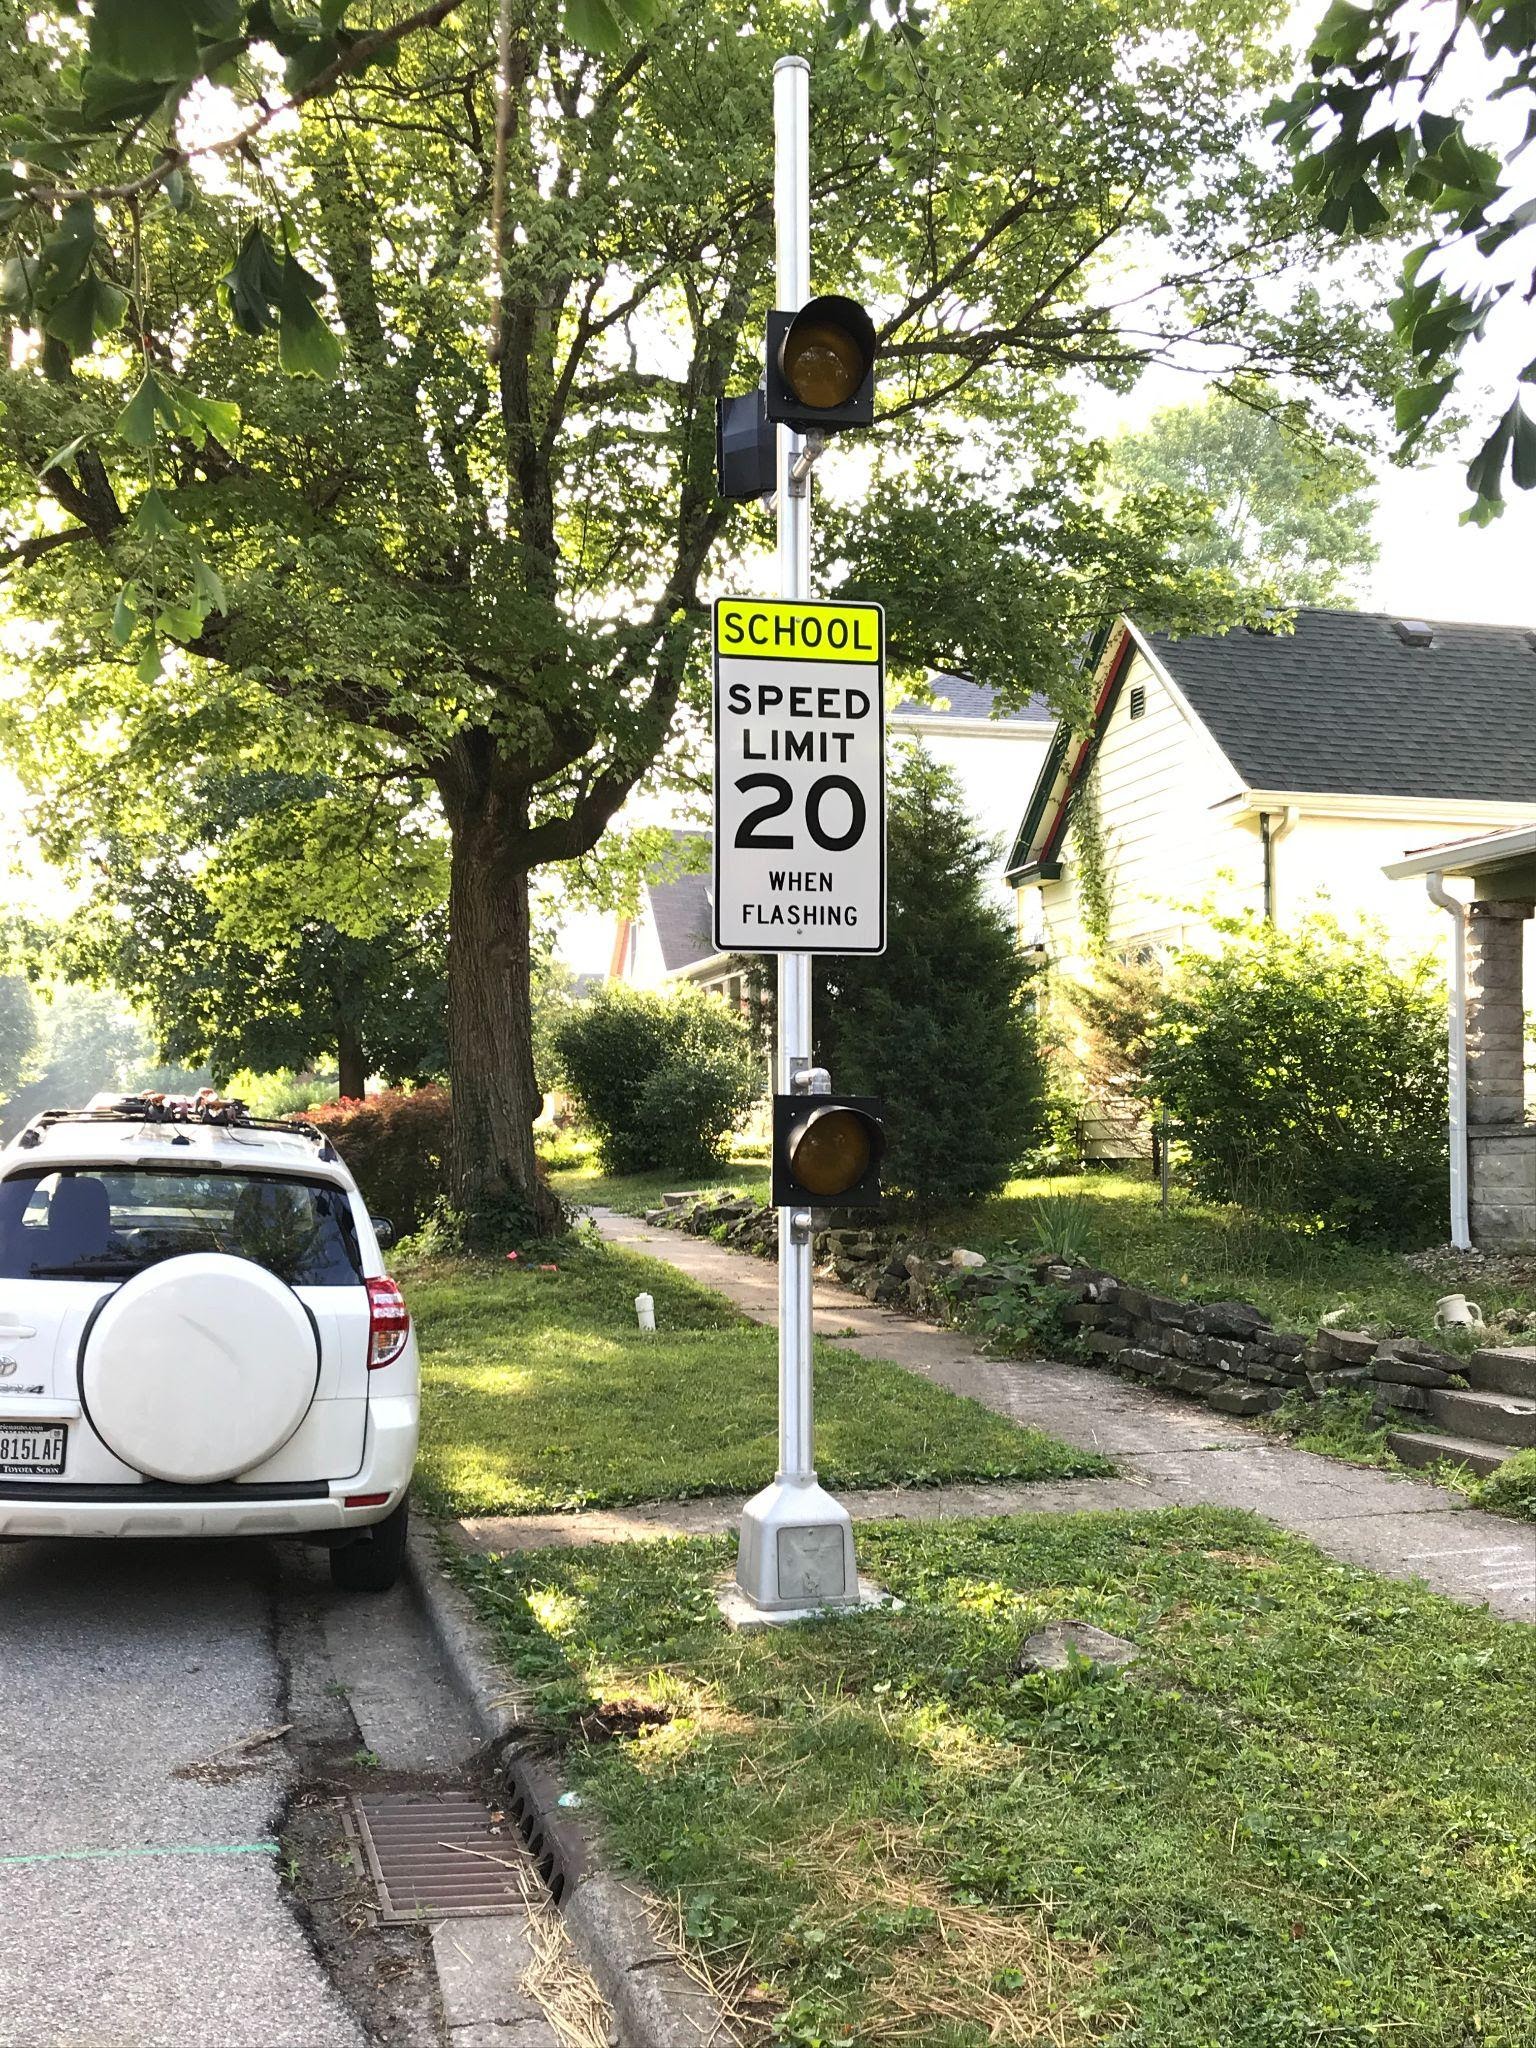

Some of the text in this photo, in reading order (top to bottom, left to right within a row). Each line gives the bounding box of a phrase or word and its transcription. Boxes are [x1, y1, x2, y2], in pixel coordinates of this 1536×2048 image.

[724, 612, 872, 651] SCHOOL
[727, 683, 871, 720] SPEED
[743, 729, 855, 763] LIMIT
[734, 772, 867, 852] 20
[768, 871, 833, 892] WHEN
[742, 904, 858, 927] FLASHING
[1, 1438, 62, 1460] 815LAF
